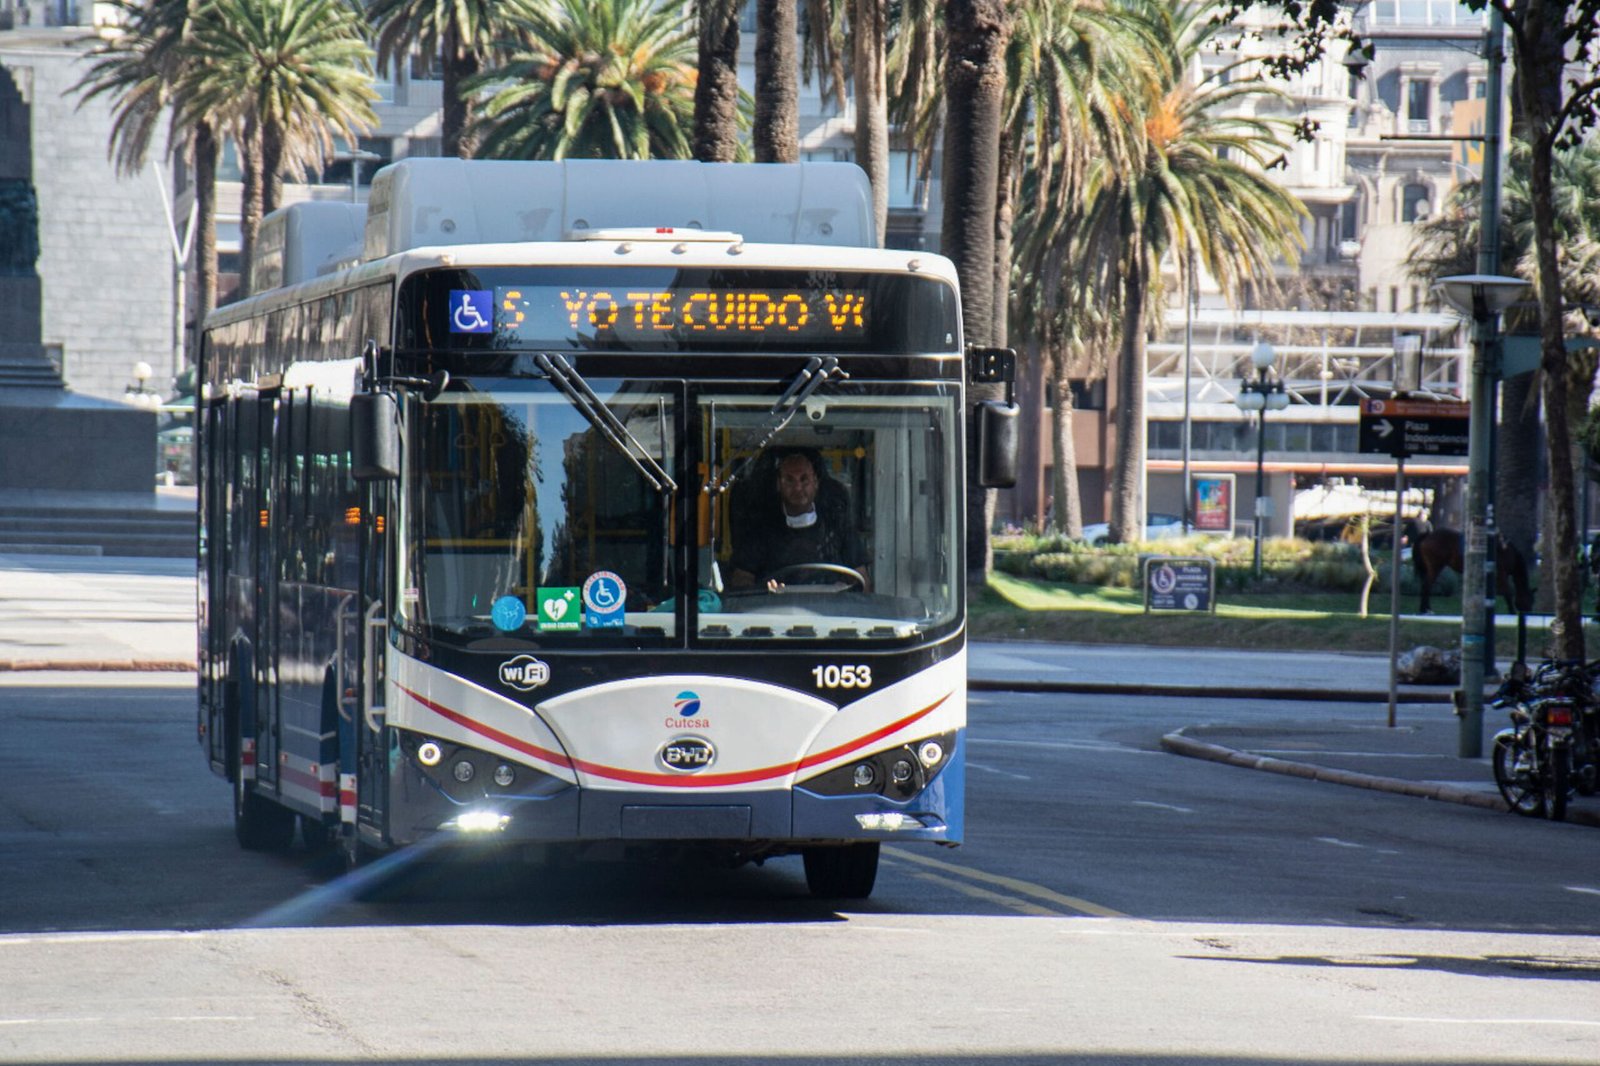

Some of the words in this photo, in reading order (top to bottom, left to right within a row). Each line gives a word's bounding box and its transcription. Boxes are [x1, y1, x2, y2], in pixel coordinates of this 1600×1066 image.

[560, 291, 618, 329] YO
[627, 292, 674, 330] TE
[682, 293, 808, 331] CUIDO
[1404, 420, 1429, 431] Plaza
[503, 667, 544, 681] WiFi
[812, 664, 872, 688] 1053
[664, 717, 710, 729] Cutcsa
[666, 746, 709, 764] BYD
